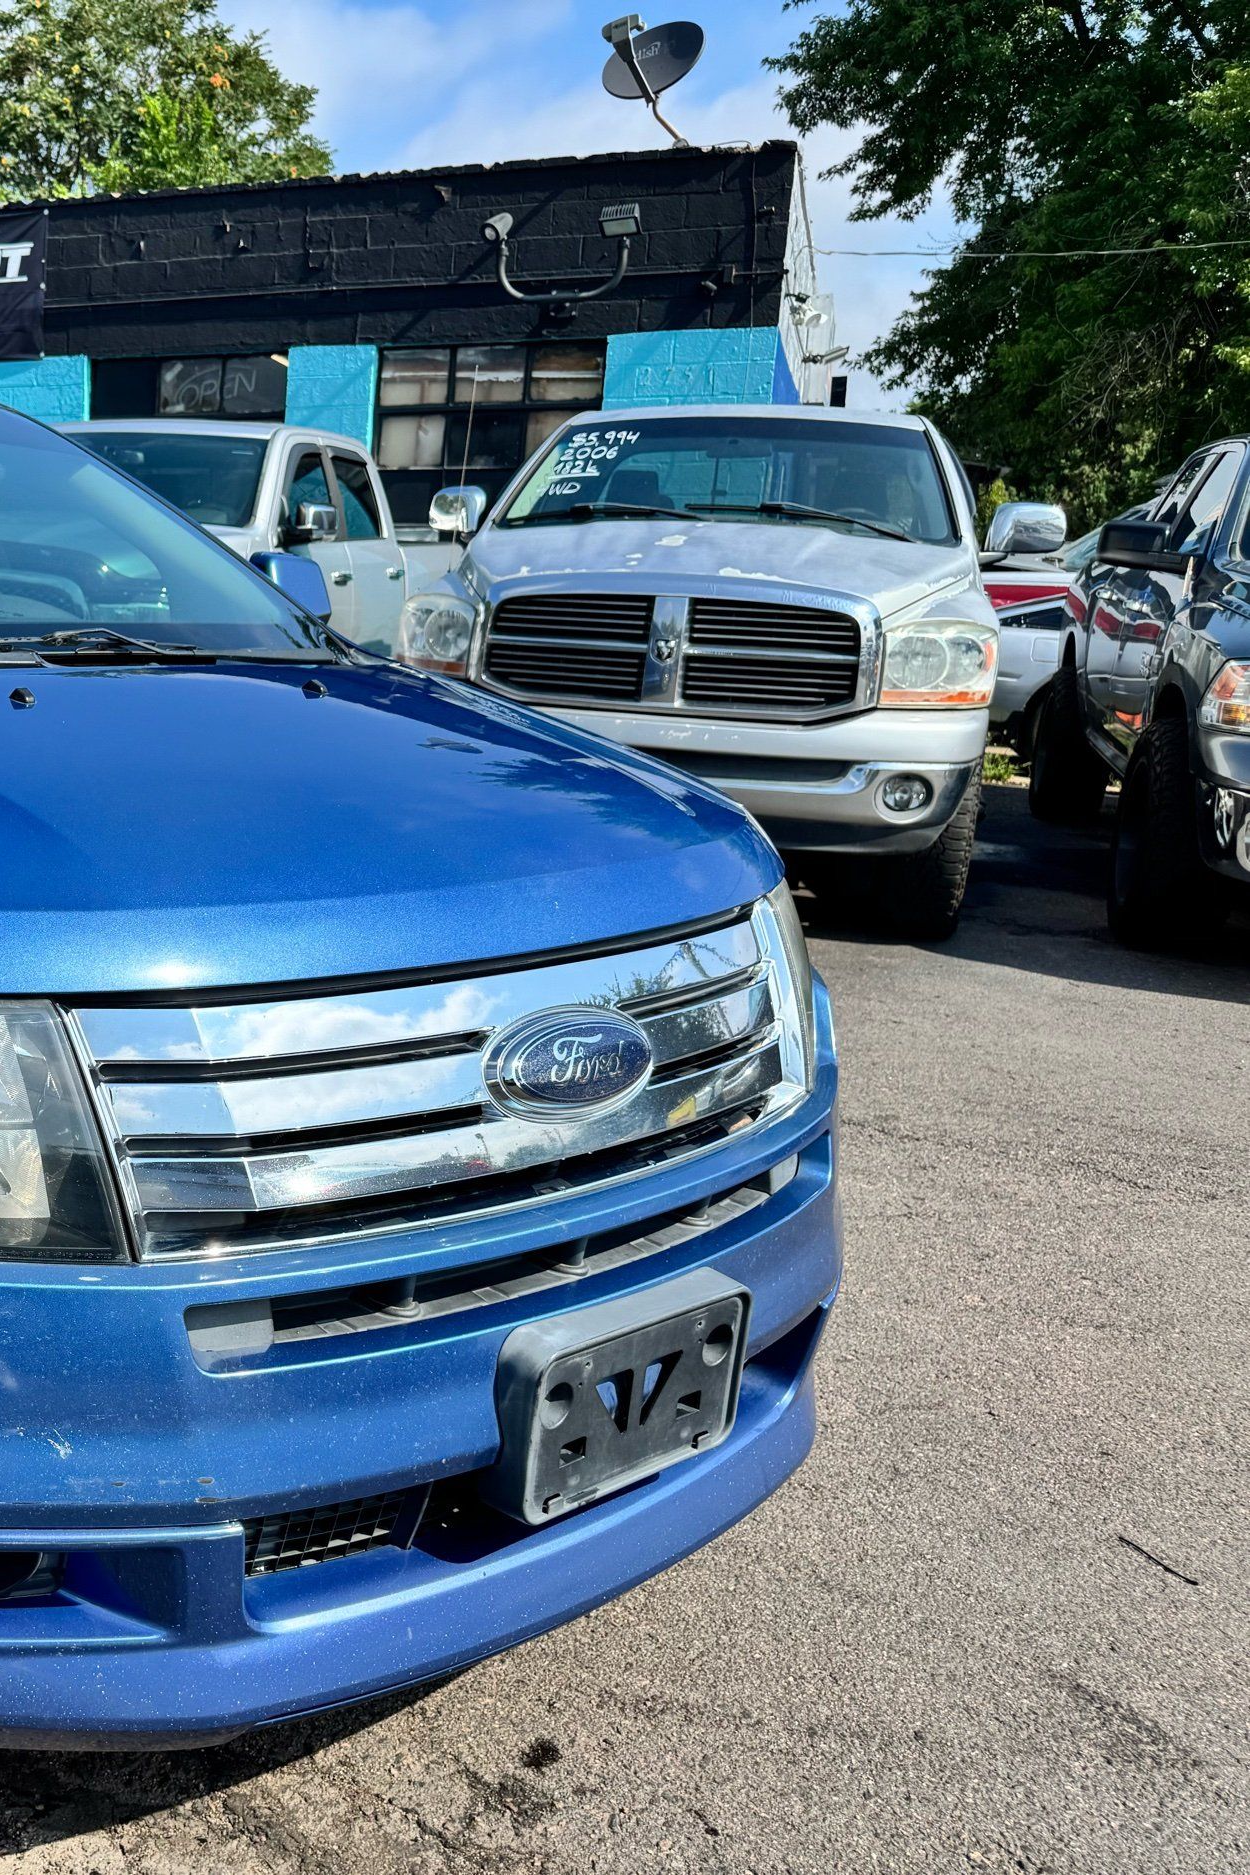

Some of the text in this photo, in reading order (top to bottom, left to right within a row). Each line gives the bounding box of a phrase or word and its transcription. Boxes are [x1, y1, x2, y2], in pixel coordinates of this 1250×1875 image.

[179, 369, 256, 408] OPEN
[560, 446, 619, 461] 2006
[551, 1033, 625, 1088] Ford
